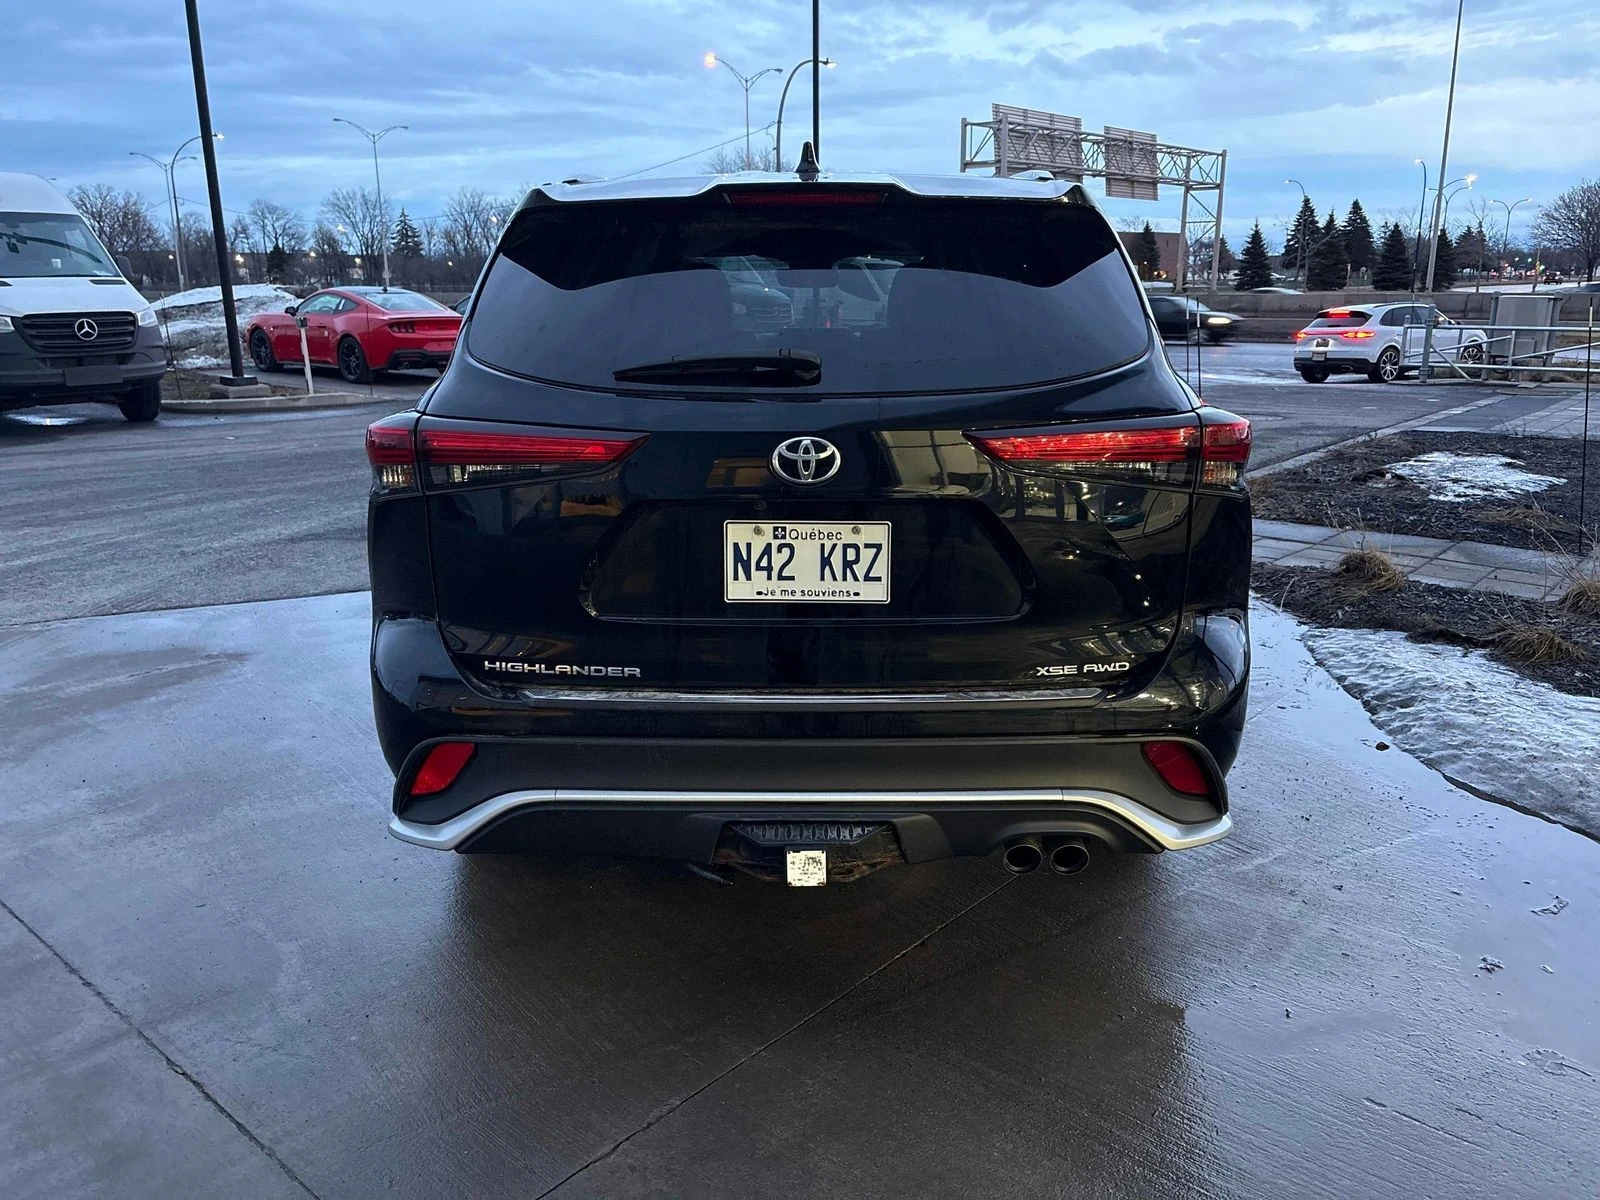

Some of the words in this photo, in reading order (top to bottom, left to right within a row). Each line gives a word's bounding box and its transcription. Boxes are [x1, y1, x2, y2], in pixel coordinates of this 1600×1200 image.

[788, 527, 843, 541] Québec
[732, 541, 796, 581] N42
[819, 543, 883, 582] KRZ
[763, 587, 777, 597] Je
[780, 588, 797, 597] me
[800, 587, 851, 598] souviens
[484, 660, 641, 678] HIGHLANDER
[1035, 664, 1079, 676] XSE
[1083, 661, 1130, 673] AWD
